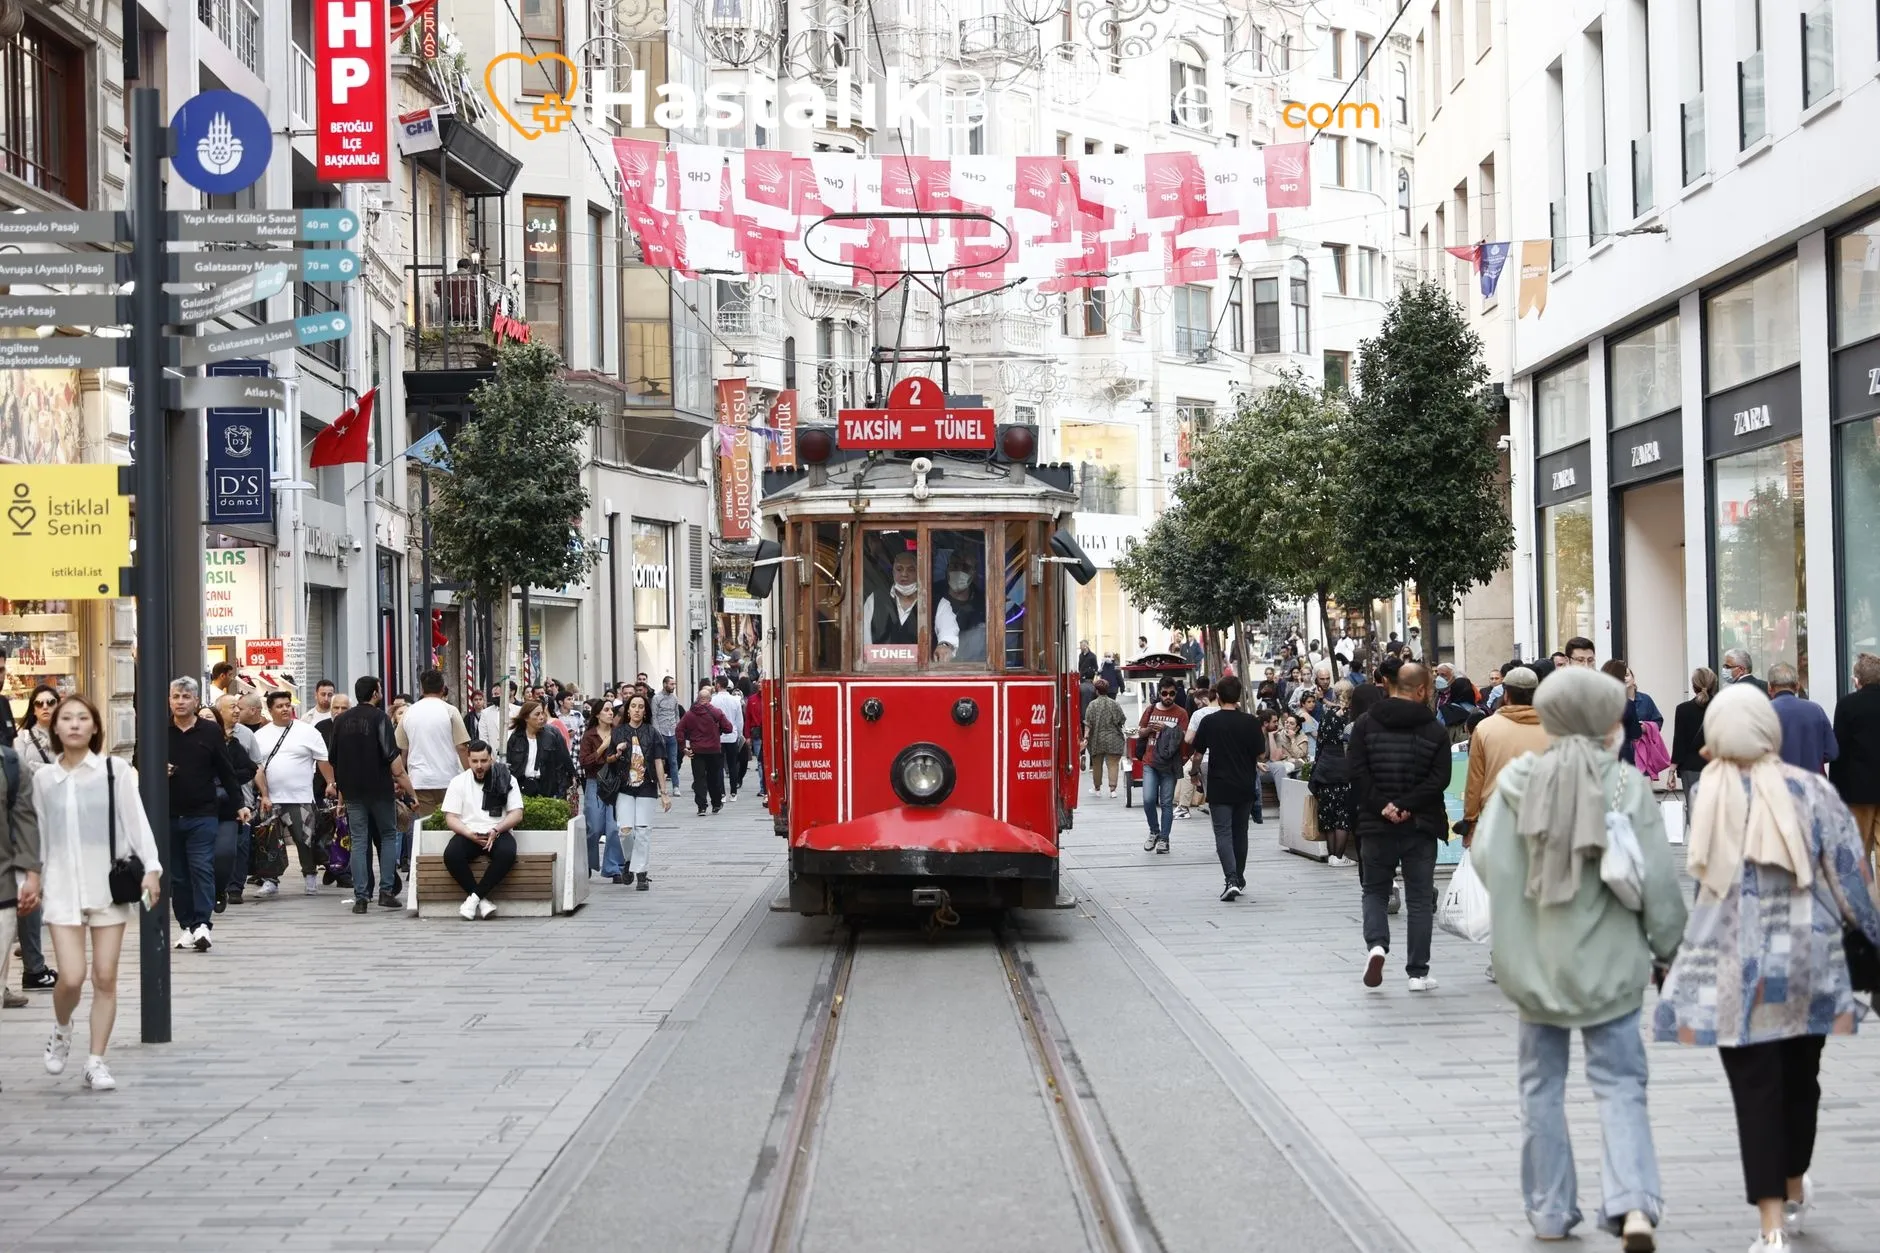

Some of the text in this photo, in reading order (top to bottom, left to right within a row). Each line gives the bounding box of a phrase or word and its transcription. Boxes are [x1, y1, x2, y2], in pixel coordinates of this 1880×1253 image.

[423, 7, 436, 57] ERAS
[330, 120, 373, 133] BEYOĞLU
[342, 136, 362, 152] İLÇE
[324, 153, 380, 168] BAŞKANLIĞI
[183, 214, 296, 225] Yapı Kredi Kültür Sanat
[306, 220, 319, 230] 40
[50, 222, 79, 234] Pasajı
[257, 226, 297, 235] Merkezi
[35, 264, 74, 276] (Aynalı)
[75, 264, 104, 276] Pasajı
[194, 262, 252, 273] Galatasaray
[307, 261, 319, 271] 70
[27, 306, 56, 318] Pasajı
[301, 323, 329, 335] 130 m
[208, 328, 292, 353] Galatasaray Lisesi
[244, 387, 269, 397] Atlas
[909, 380, 922, 405] 2
[844, 415, 902, 440] TAKSİM
[935, 414, 985, 440] TÜNEL
[1733, 404, 1773, 437] ZARA
[733, 390, 750, 530] SÜRÜCÜ KURSU
[1631, 441, 1661, 467] ZARA
[1552, 467, 1576, 491] ZARA
[48, 496, 109, 516] İstiklal
[220, 497, 259, 506] damat
[48, 519, 102, 536] Senin
[51, 567, 103, 577] istiklal.ist
[206, 570, 237, 583] ASIL
[18, 648, 47, 666] KOSKA
[871, 648, 914, 659] TÜNEL
[797, 705, 813, 725] 223
[1031, 705, 1046, 724] 223
[812, 760, 831, 768] YASAK
[1018, 760, 1041, 768] ASILMAK
[1017, 772, 1025, 780] VE
